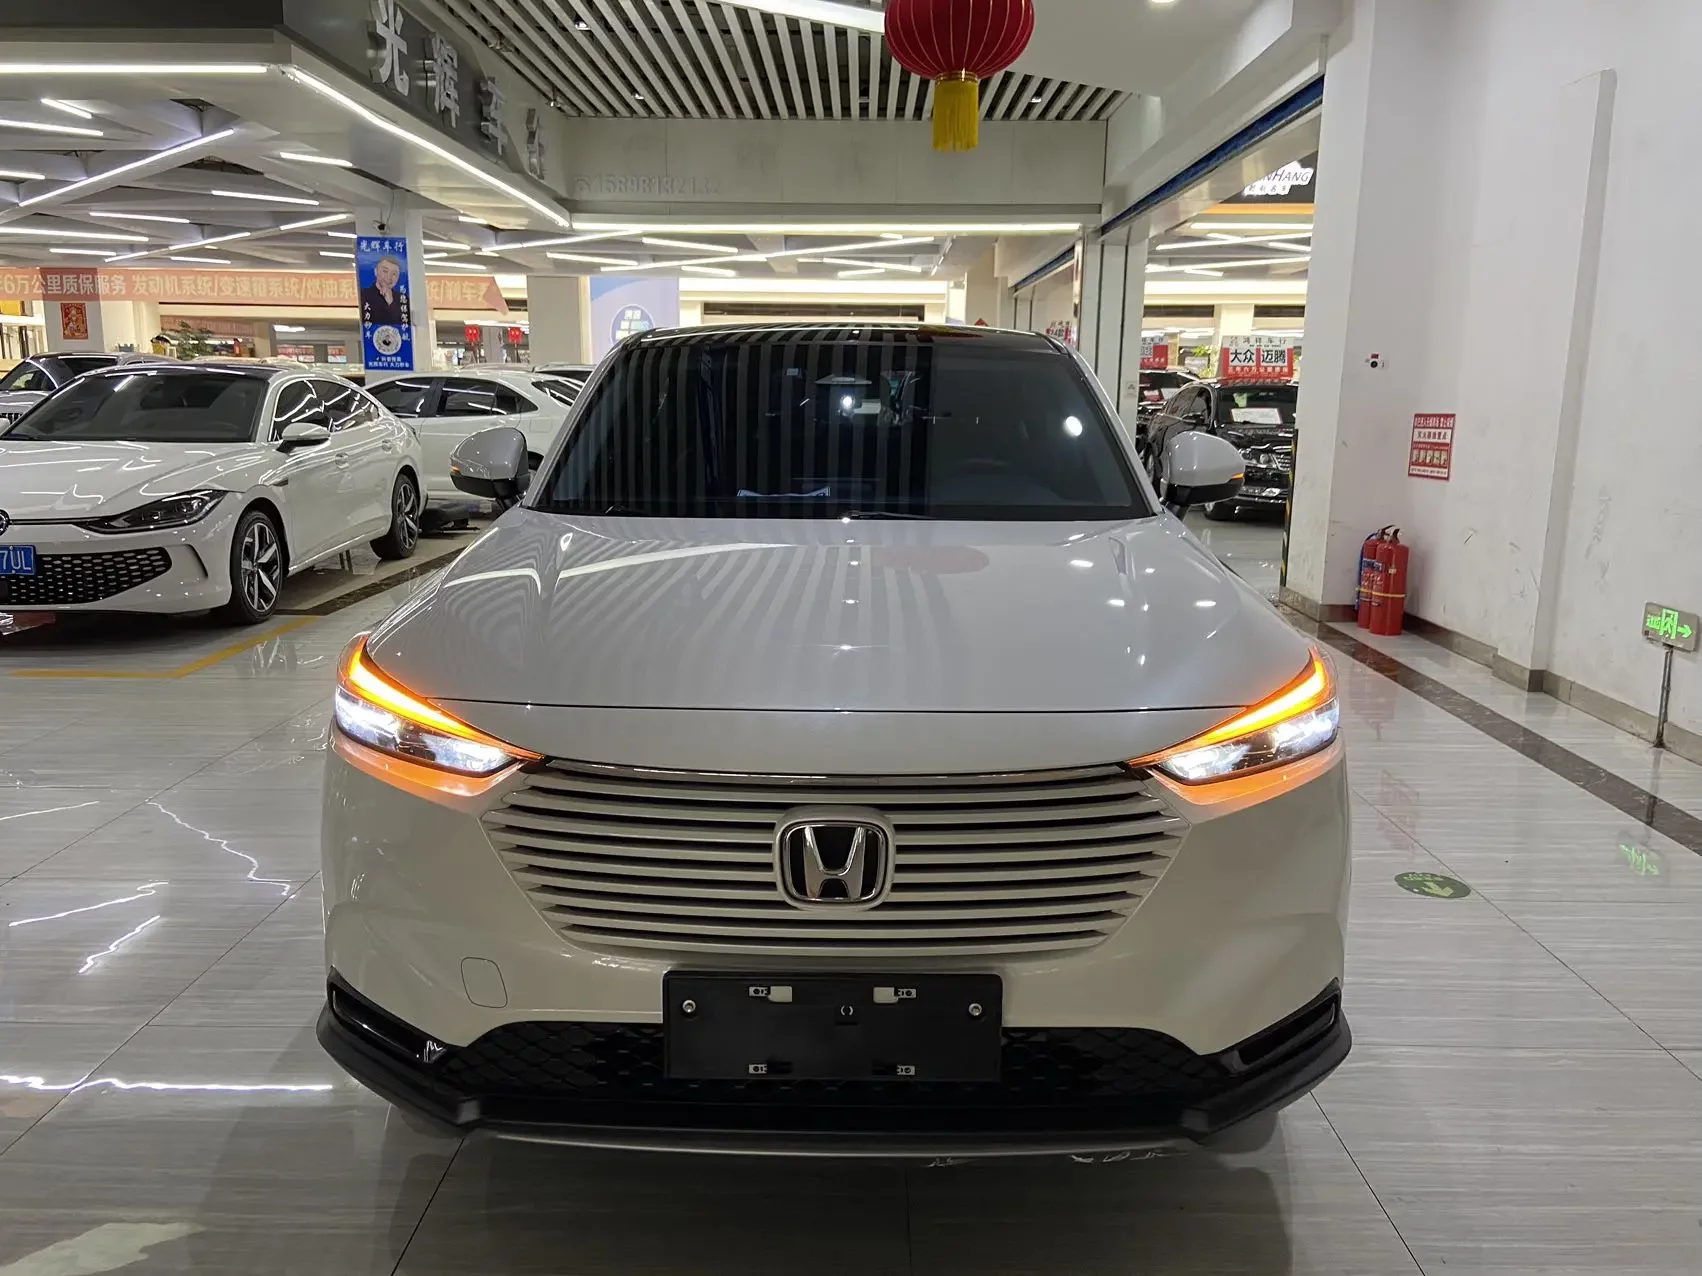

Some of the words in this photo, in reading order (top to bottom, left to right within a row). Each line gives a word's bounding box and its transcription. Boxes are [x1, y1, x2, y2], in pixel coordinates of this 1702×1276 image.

[368, 0, 546, 181] 光辉车
[0, 273, 127, 297] 6万公里质保服务
[1230, 348, 1255, 364] 大众
[1261, 348, 1287, 364] 迈腾
